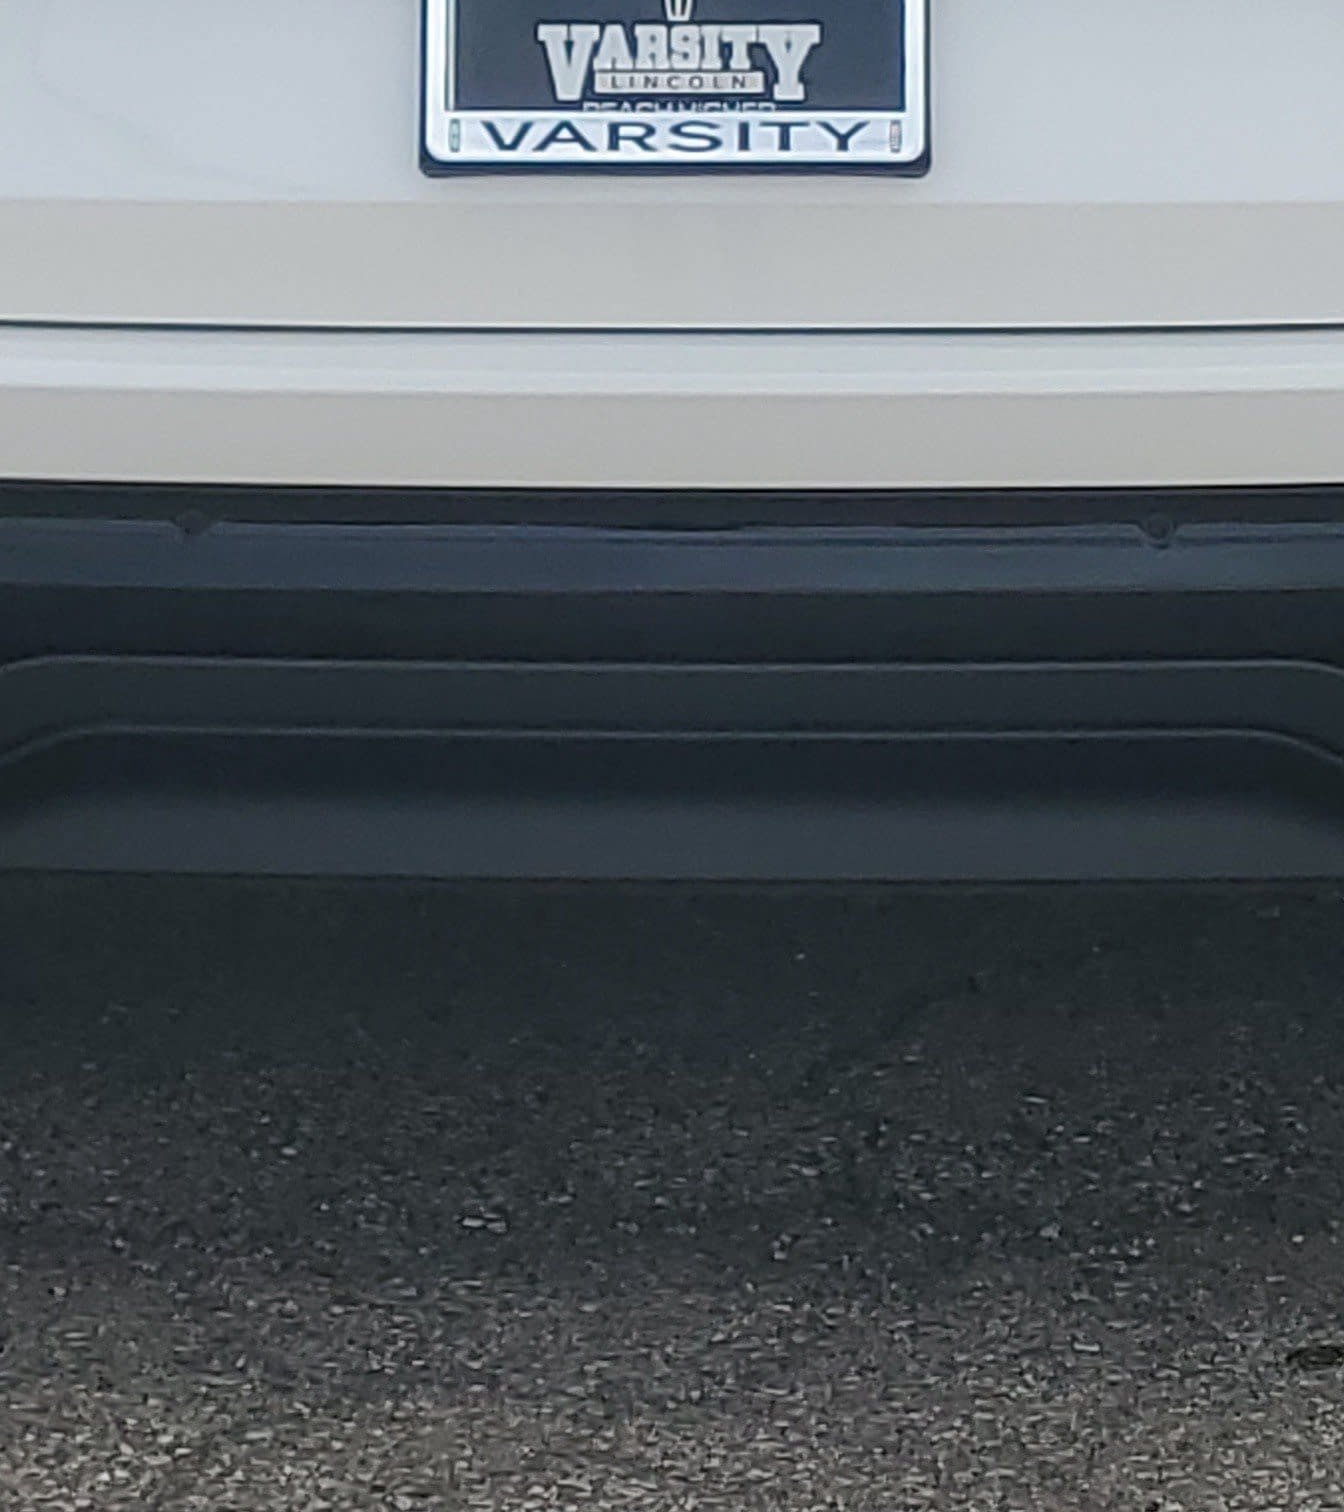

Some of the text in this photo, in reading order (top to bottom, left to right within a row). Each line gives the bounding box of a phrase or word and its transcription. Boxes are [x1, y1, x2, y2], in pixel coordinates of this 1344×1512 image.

[537, 23, 821, 102] VARSITY
[610, 75, 748, 89] LINCOLN
[481, 120, 871, 152] VARSITY
